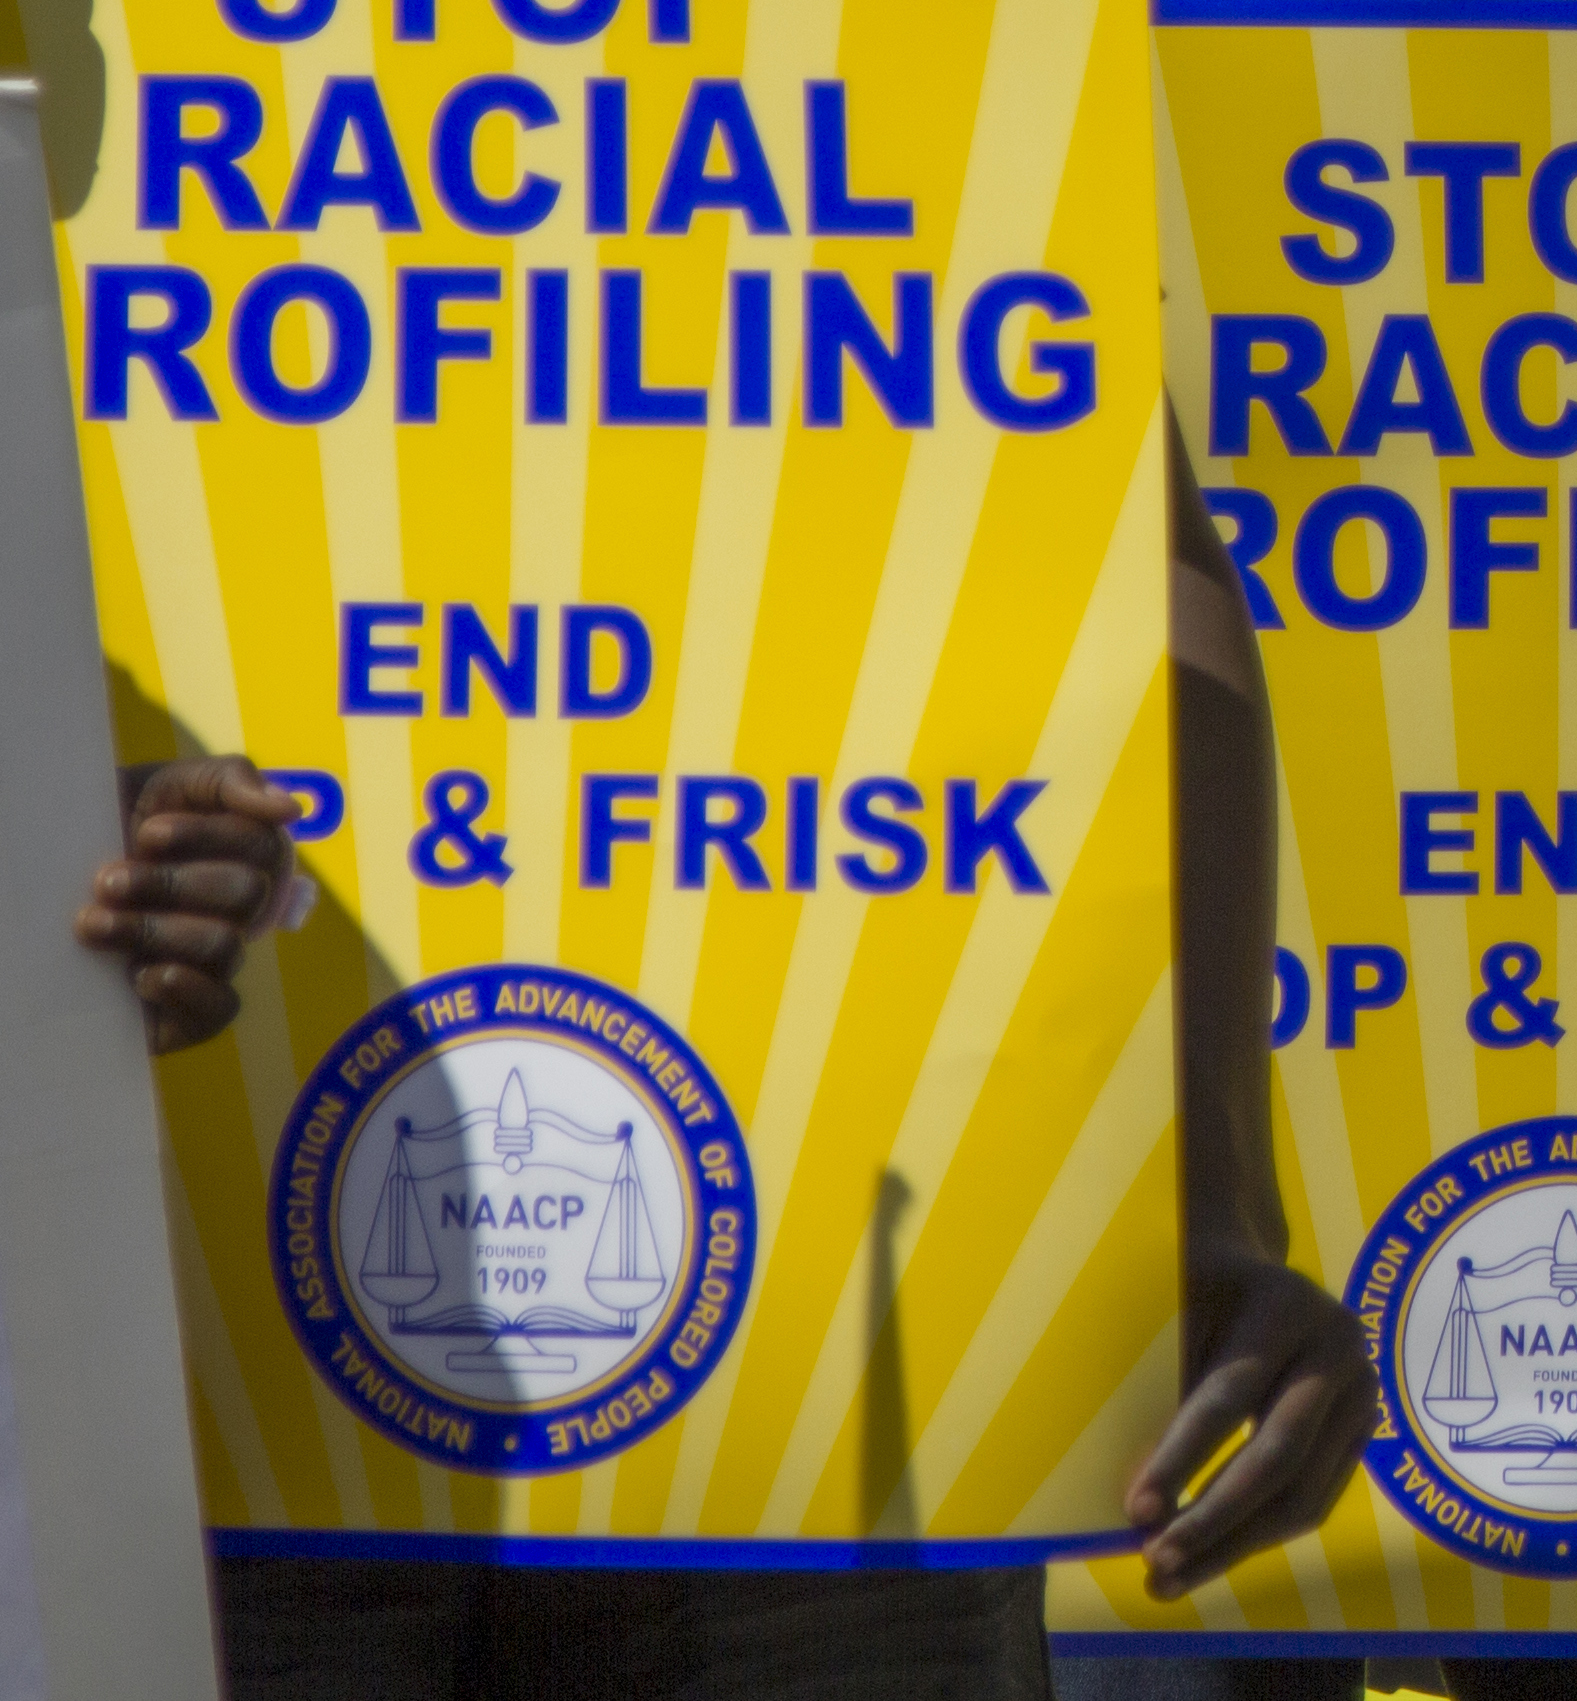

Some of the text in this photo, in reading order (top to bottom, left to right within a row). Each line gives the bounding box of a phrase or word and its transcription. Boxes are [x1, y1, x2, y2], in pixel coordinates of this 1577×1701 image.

[136, 74, 915, 237] RACIAL
[84, 262, 1097, 433] ROFILING
[338, 601, 653, 719] END
[408, 770, 515, 888] &
[579, 773, 1052, 895] FRISK
[1466, 941, 1566, 1049] &
[440, 1194, 584, 1231] NAACP
[1404, 1175, 1464, 1232] FOR
[1469, 1139, 1532, 1182] THE
[288, 983, 736, 1455] NATIONAL ASSOCIATION FOR THE ADVANCEMENT OF COLORED PEOPLE
[476, 1245, 547, 1259] FOUNDED
[476, 1268, 547, 1294] 1909
[1392, 1451, 1525, 1557] NATIONAL
